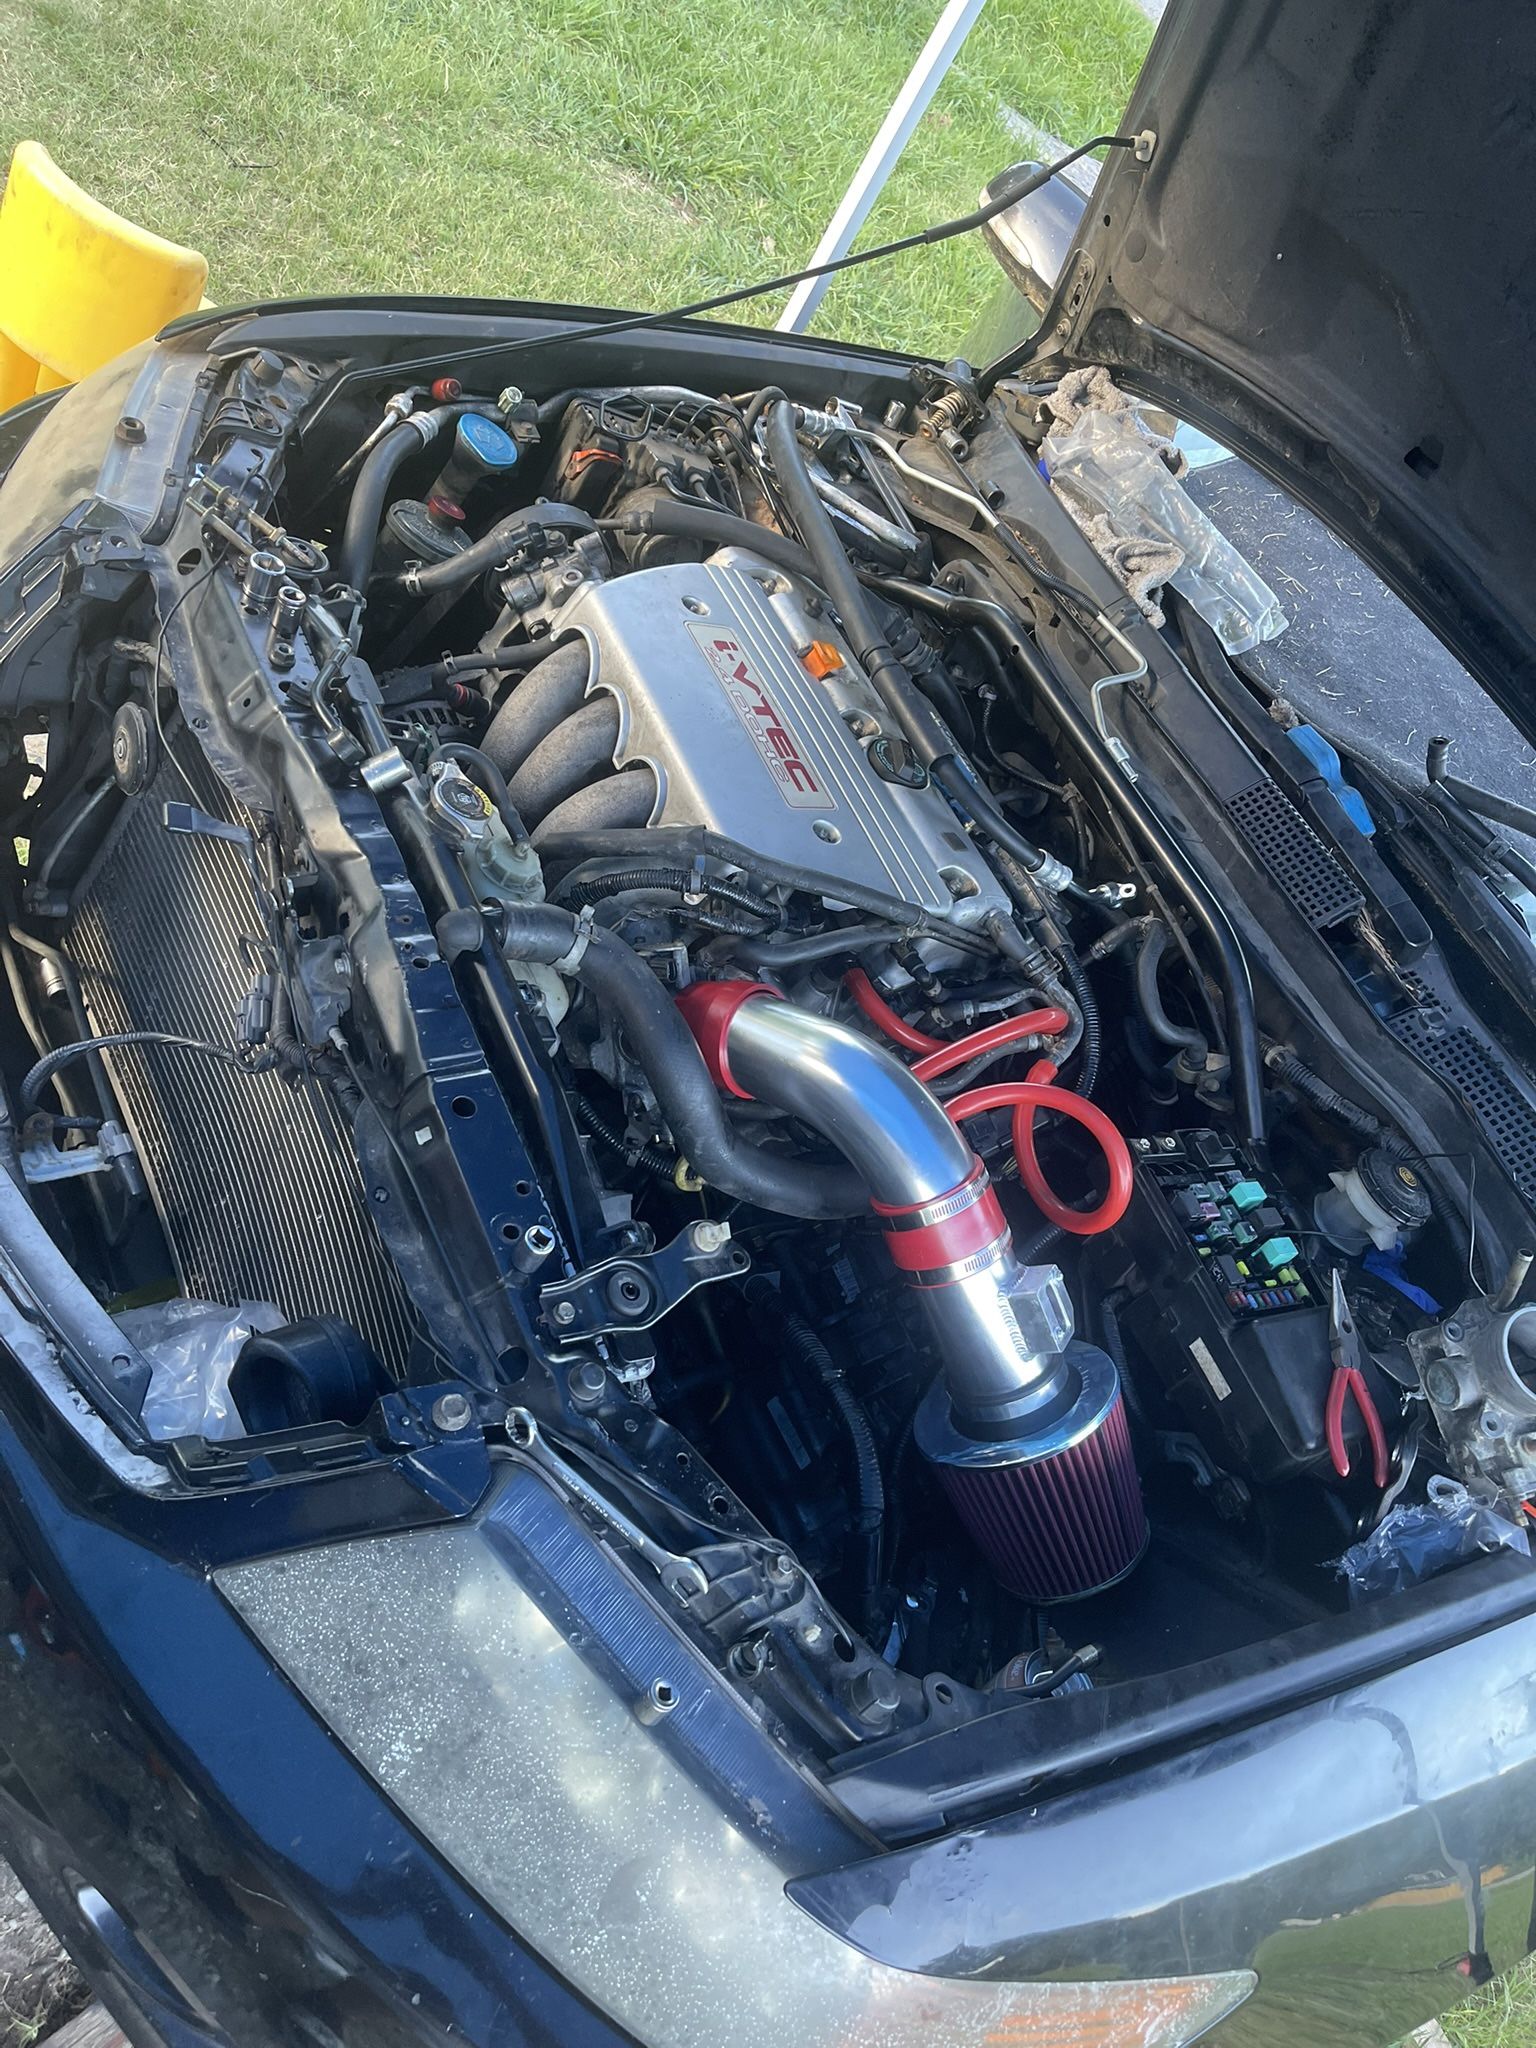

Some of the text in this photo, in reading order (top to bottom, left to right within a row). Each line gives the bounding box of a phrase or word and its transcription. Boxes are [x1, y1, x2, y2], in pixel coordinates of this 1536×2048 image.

[704, 646, 789, 783] 2.4 DOHC
[713, 640, 819, 792] i-VTEC
